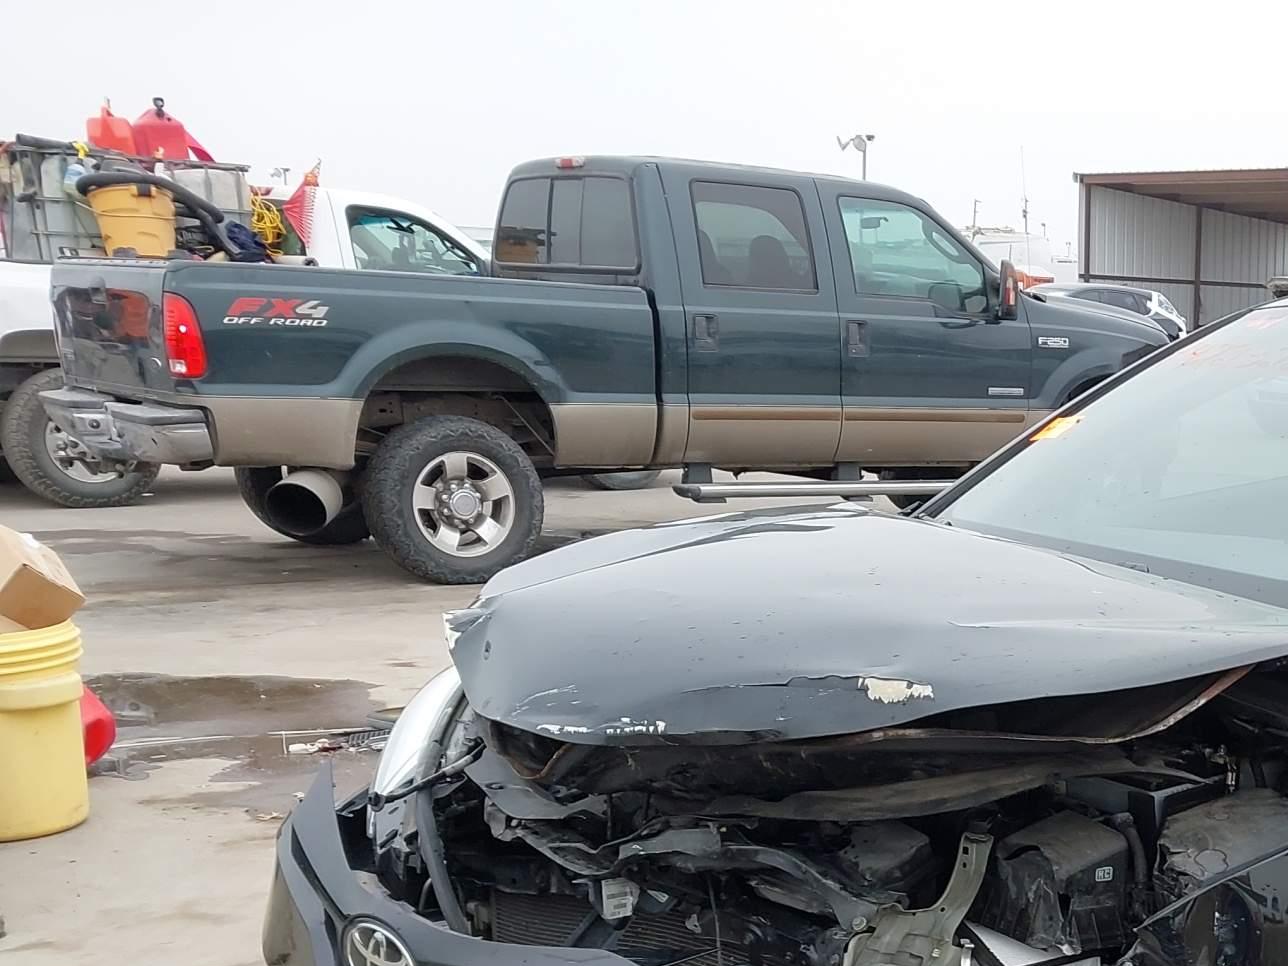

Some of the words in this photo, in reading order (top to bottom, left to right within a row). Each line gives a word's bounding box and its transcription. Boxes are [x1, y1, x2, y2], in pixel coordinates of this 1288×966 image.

[226, 297, 330, 318] FX4
[223, 317, 264, 325] OFF
[269, 318, 328, 327] ROAD
